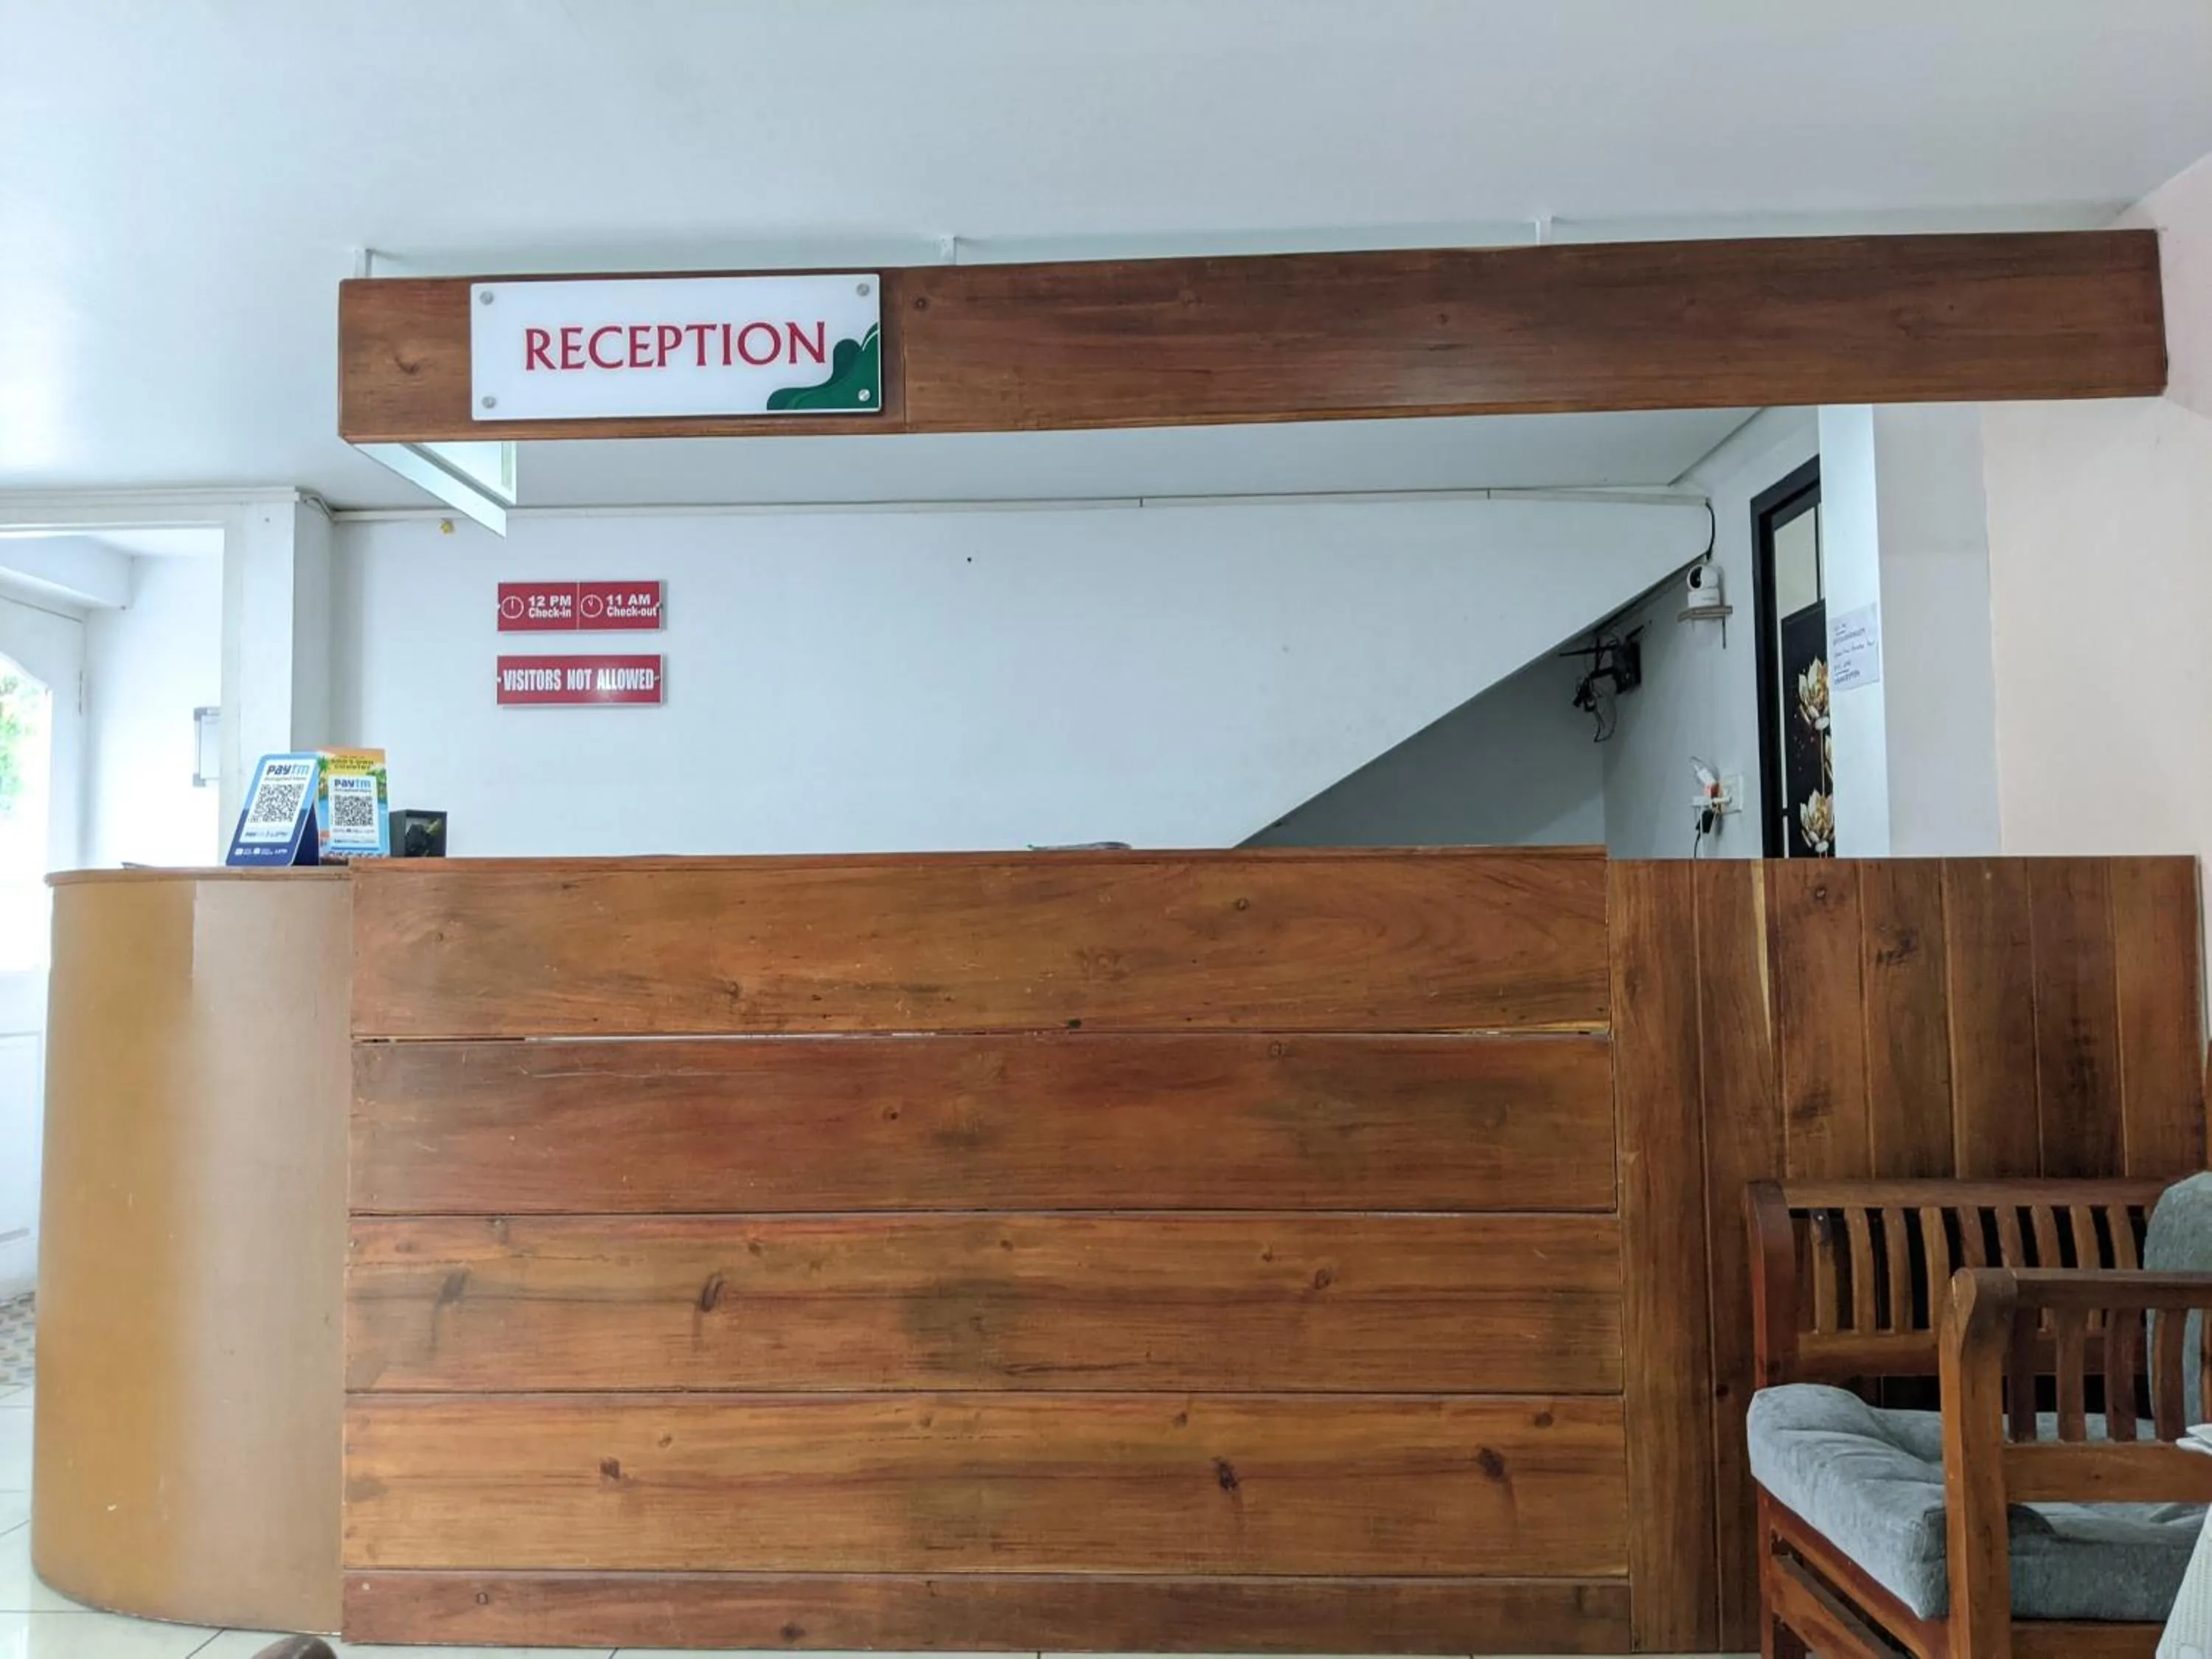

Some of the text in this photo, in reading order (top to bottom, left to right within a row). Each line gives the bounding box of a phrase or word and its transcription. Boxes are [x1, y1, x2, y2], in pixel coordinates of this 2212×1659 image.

[524, 321, 827, 370] RECEPTION
[528, 595, 572, 607] 12 PM
[606, 594, 651, 605] 11 AM
[528, 607, 572, 618] Check-in
[607, 605, 657, 617] Check-out
[503, 668, 655, 691] VISITORS NOT ALLOWED
